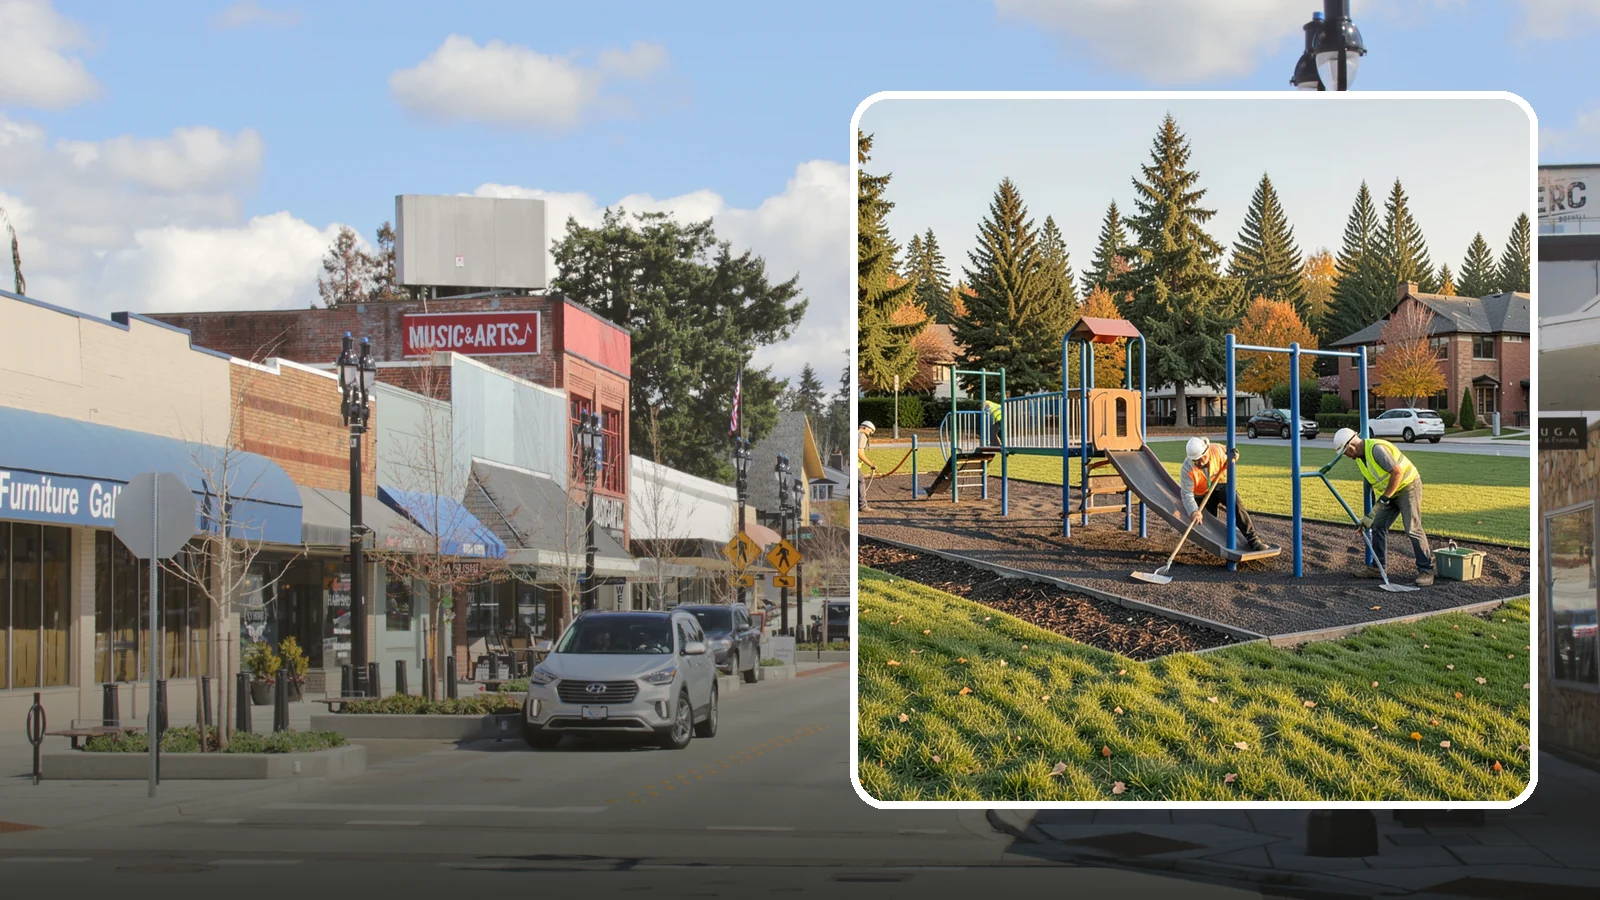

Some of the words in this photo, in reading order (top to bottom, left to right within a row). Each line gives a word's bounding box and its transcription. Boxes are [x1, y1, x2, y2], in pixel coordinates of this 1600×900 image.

[0, 471, 79, 515] Furniture
[89, 482, 122, 519] Gal
[453, 563, 479, 574] SUSHI
